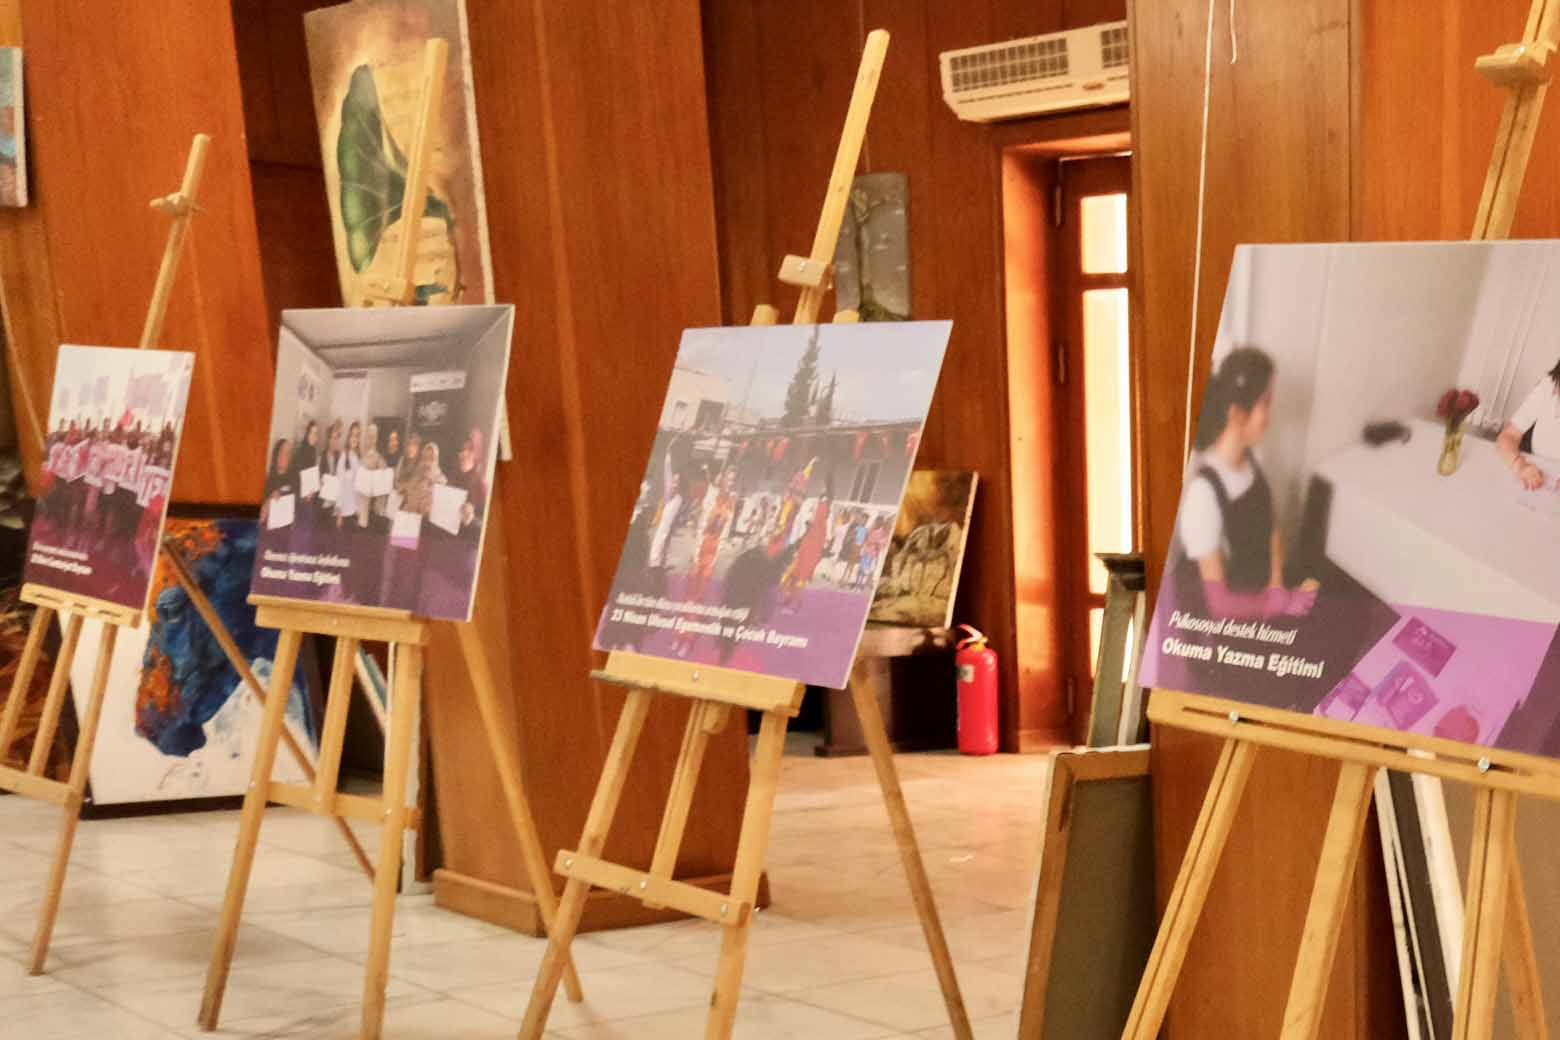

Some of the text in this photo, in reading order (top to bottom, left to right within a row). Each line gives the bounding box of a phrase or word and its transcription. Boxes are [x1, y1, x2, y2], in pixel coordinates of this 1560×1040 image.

[1222, 618, 1258, 639] destek
[1256, 623, 1298, 645] hizmeti
[1162, 637, 1325, 679] Okuma Yazma Eğitimi
